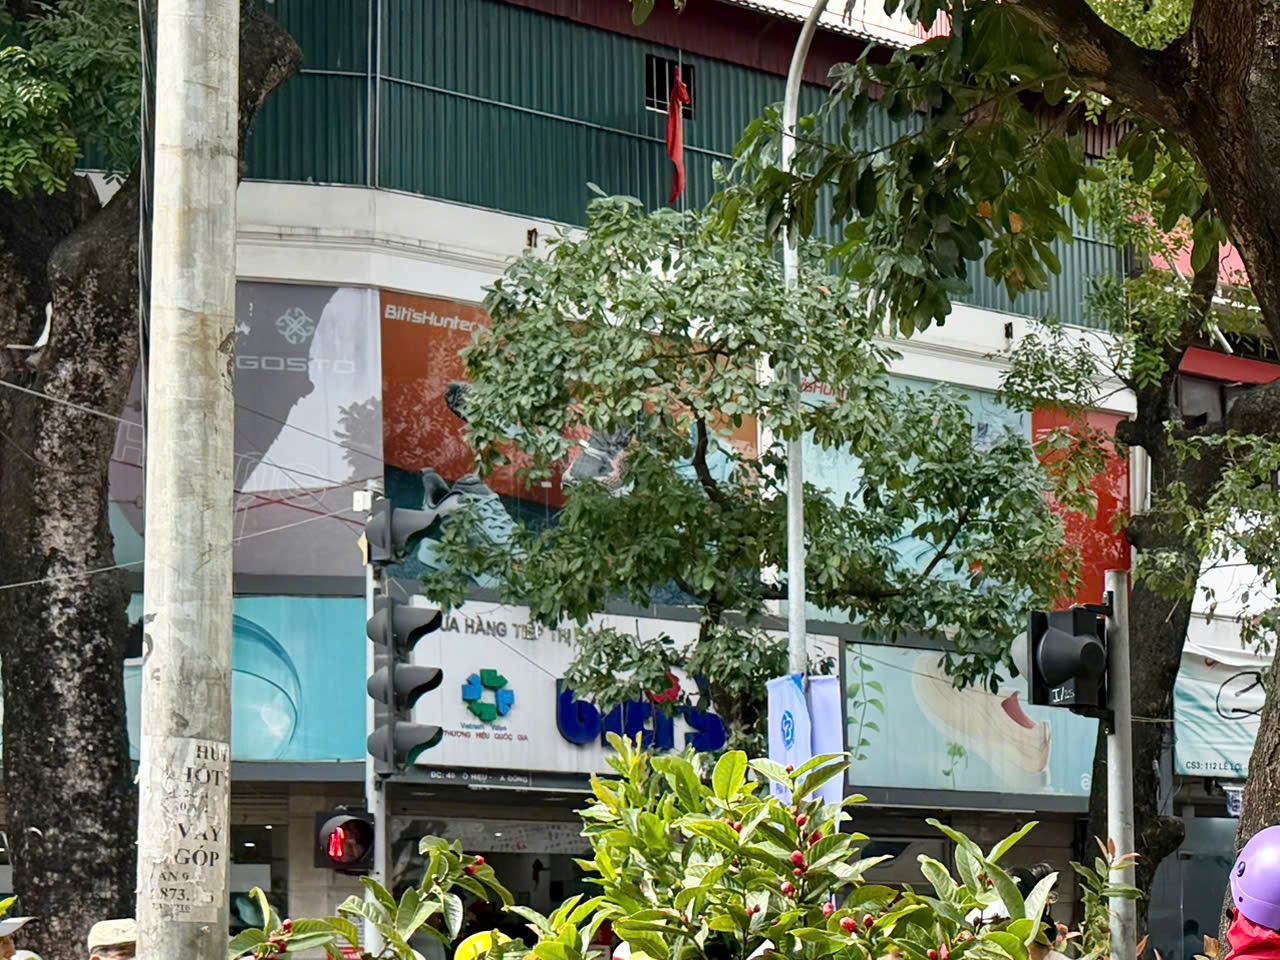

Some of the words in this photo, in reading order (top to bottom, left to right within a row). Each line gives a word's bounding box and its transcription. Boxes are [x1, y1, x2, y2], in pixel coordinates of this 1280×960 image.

[236, 355, 355, 374] GOSTO
[465, 615, 507, 637] HÀNG
[174, 845, 219, 867] GÓP
